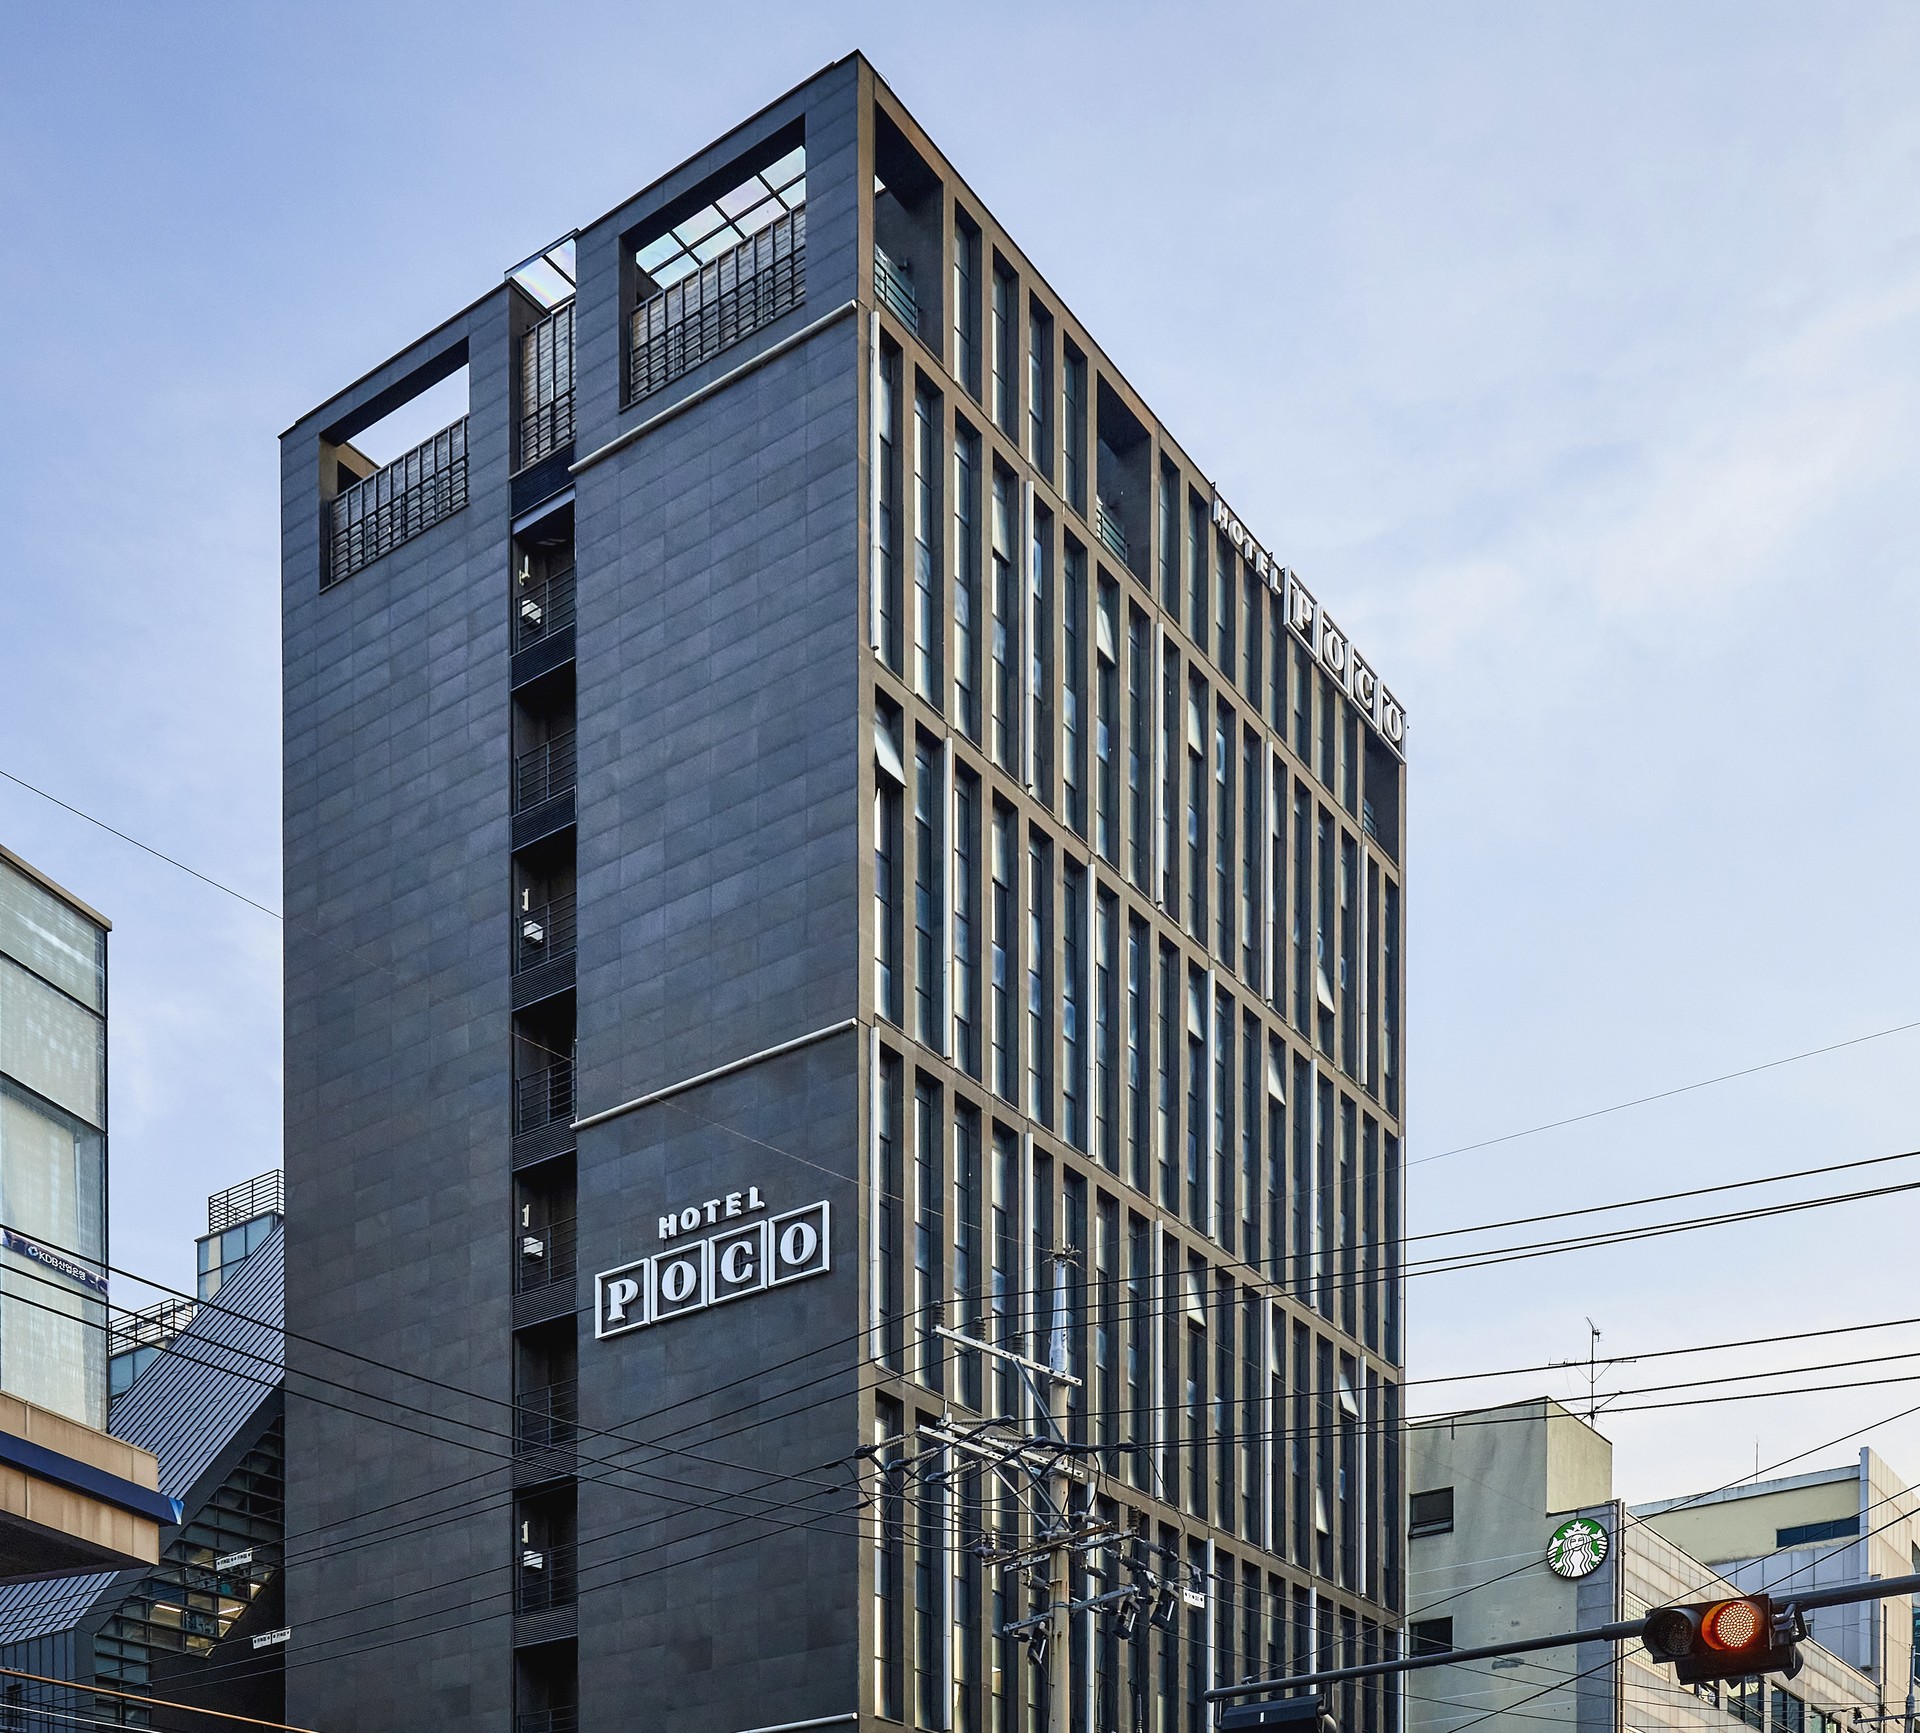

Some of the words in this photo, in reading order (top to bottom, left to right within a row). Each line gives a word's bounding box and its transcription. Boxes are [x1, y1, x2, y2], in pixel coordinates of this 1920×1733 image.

[1213, 498, 1282, 595] HOTEL
[1290, 585, 1403, 743] POCO
[658, 1186, 766, 1239] HOTEL
[607, 1222, 818, 1323] POCO
